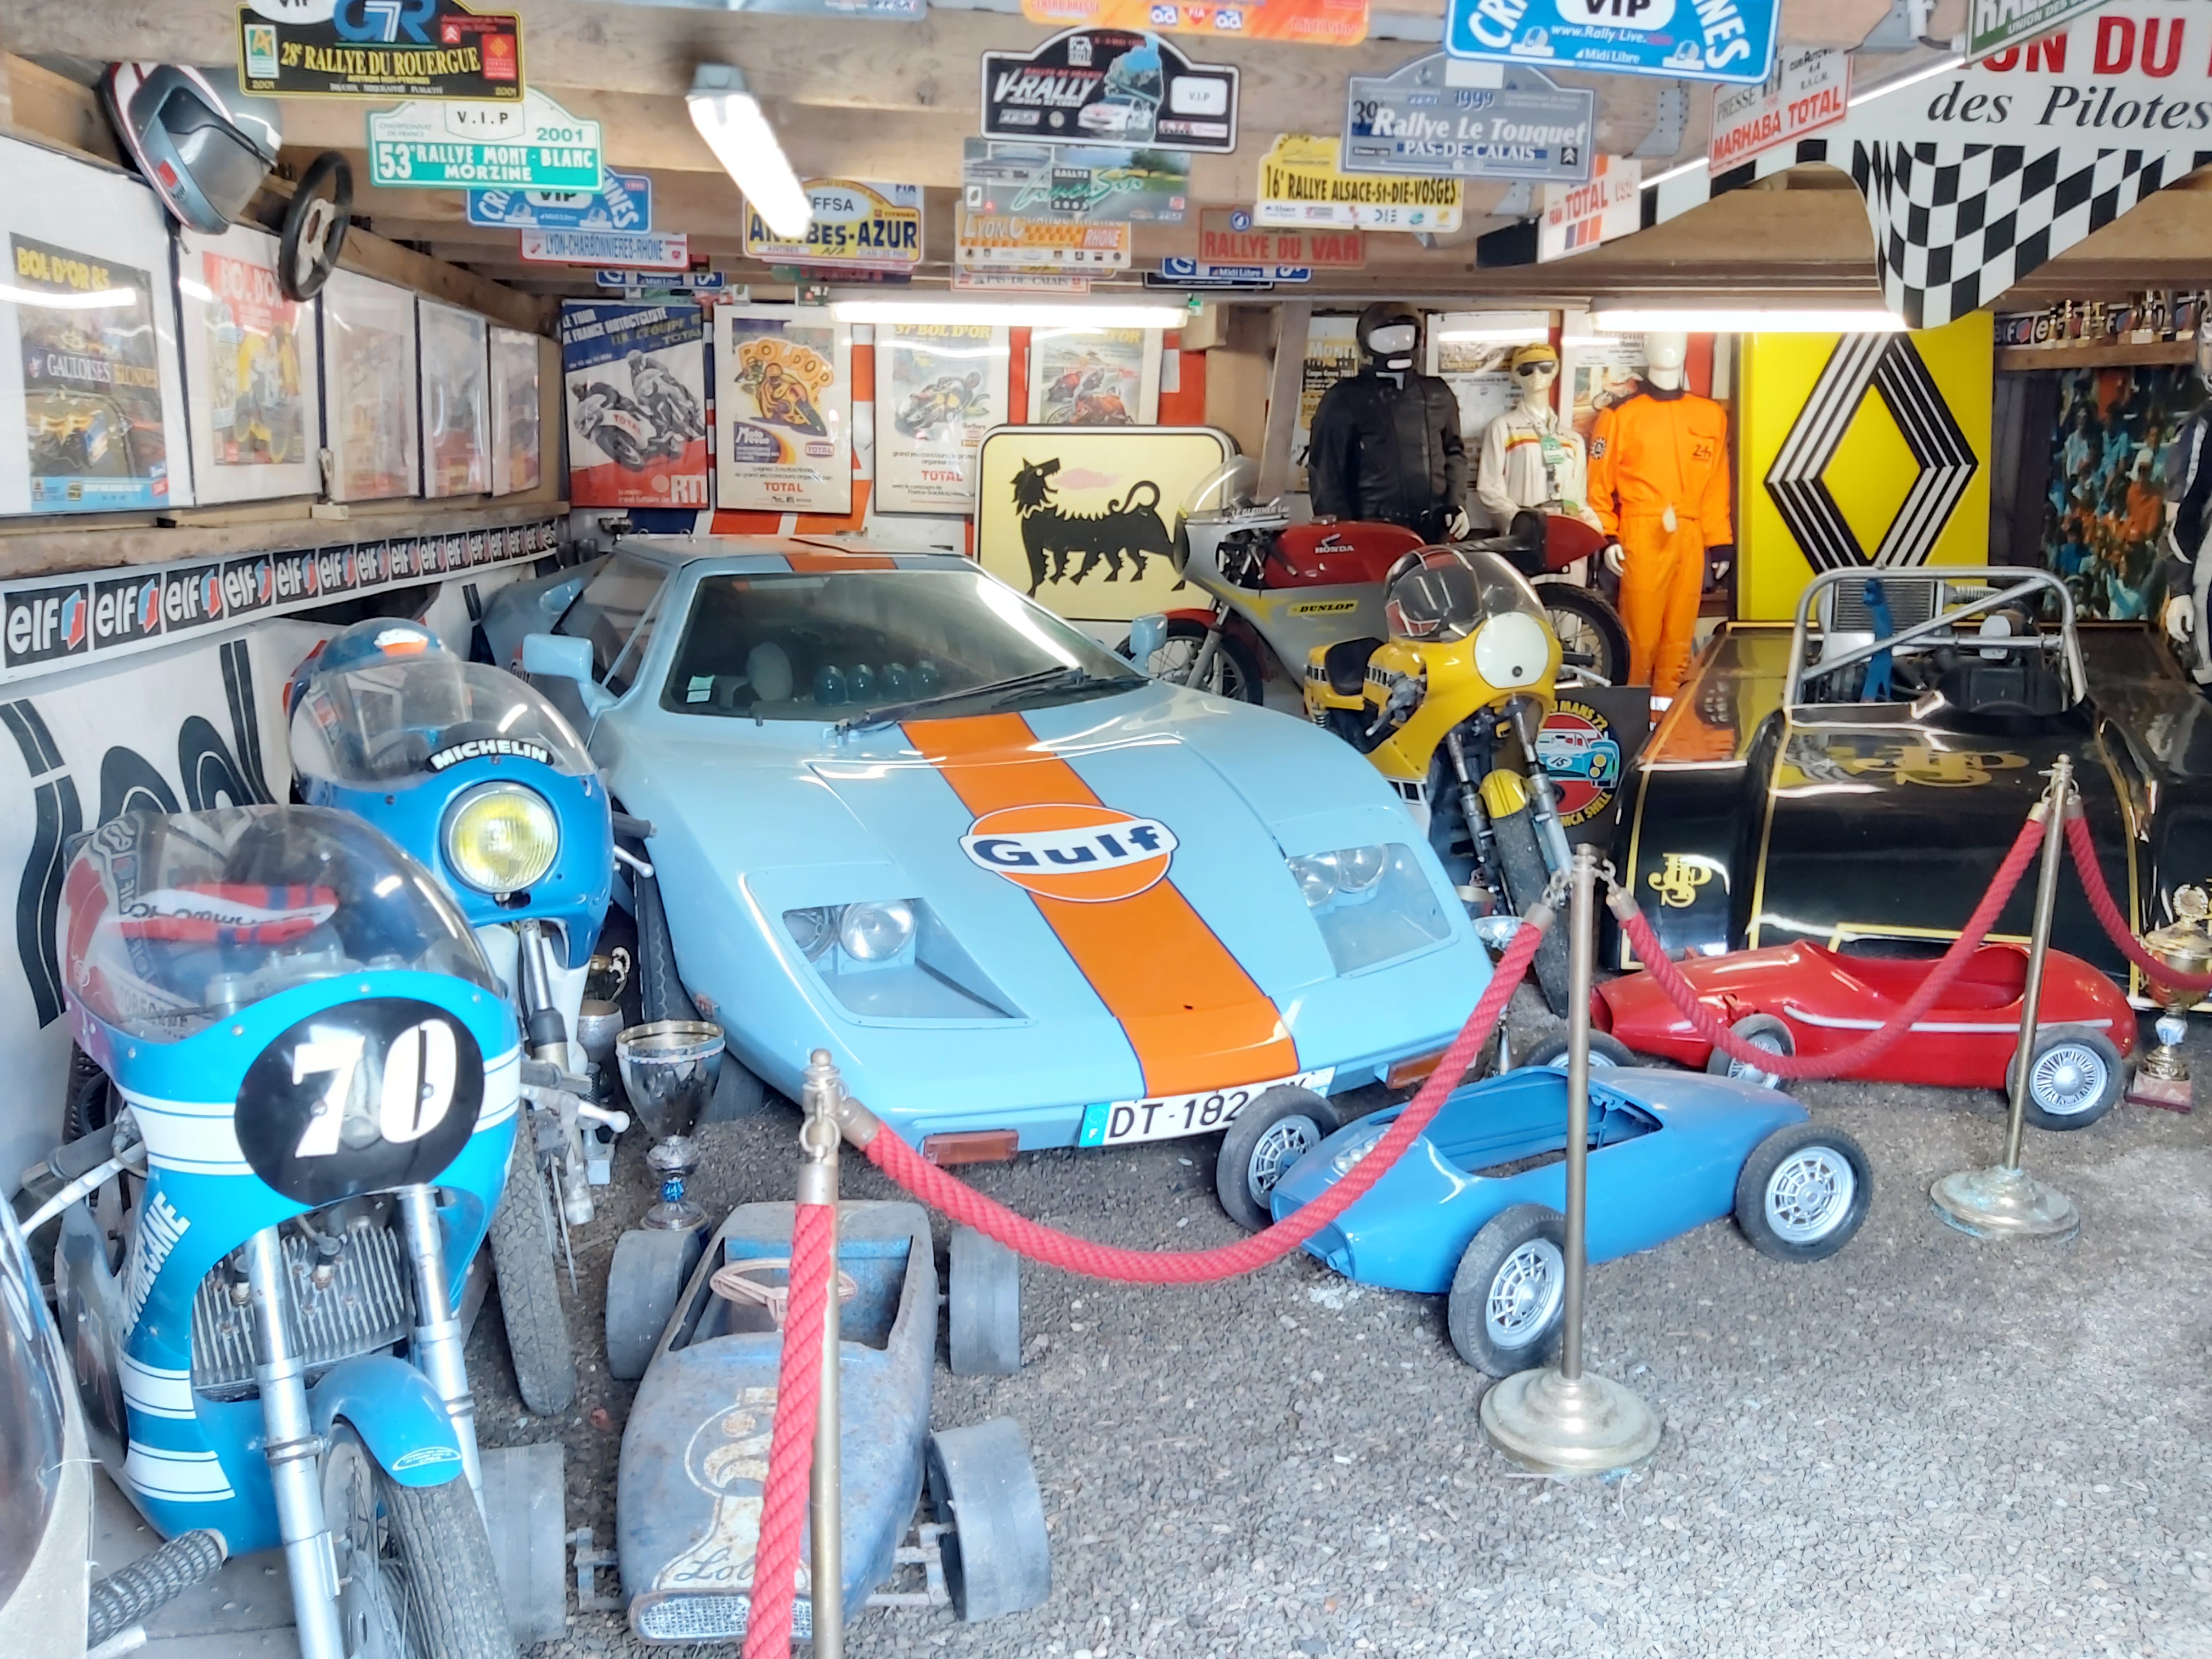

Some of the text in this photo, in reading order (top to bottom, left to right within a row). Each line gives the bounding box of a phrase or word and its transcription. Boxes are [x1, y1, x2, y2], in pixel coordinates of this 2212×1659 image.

[1189, 8, 1205, 17] FIA
[2007, 2, 2067, 34] UNION DES
[1585, 48, 1640, 64] Midi Libre
[2093, 16, 2186, 78] DU
[304, 46, 366, 74] RALLYE
[369, 51, 391, 75] DU
[393, 47, 481, 76] ROUERGUE
[993, 67, 1099, 105] V-RALLY
[1454, 89, 1494, 111] 1999
[1718, 86, 1756, 123] PRESSE
[1929, 81, 2212, 130] des Pilotes
[537, 127, 584, 142] 2001
[1371, 108, 1587, 148] Rallye Le Touquet
[1714, 86, 1842, 162] MARHABA TOTAL
[416, 145, 473, 164] RALLYE
[484, 147, 528, 166] MONT
[540, 149, 594, 168] BLANC
[1405, 140, 1536, 161] PAS-DE-CALAIS
[444, 165, 533, 183] MORZINE
[1288, 173, 1328, 201] RALLYE
[1565, 179, 1609, 219] TOTAL
[812, 197, 854, 212] FFSA
[1084, 228, 1120, 248] RHONE
[1205, 231, 1360, 261] RALLYE DU VAR
[16, 246, 110, 291] BOL D'OR 85
[572, 308, 597, 325] TOUR
[572, 322, 605, 342] FRANCE
[604, 307, 668, 334] MOTOCYCLISTE
[662, 329, 702, 345] TOTAL
[919, 324, 950, 338] BOL
[951, 326, 992, 341] D'OR
[46, 353, 110, 384] GAULOISES
[613, 414, 642, 436] TOTAL
[736, 426, 765, 444] Moto
[764, 482, 804, 493] TOTAL
[921, 470, 963, 482] TOTAL
[1314, 544, 1355, 554] HONDA
[7, 597, 60, 654] elf
[95, 585, 138, 637] elf
[165, 575, 201, 622] elf
[224, 564, 257, 608] elf
[276, 557, 302, 596] elf
[319, 552, 342, 588] elf
[358, 548, 378, 581] elf
[391, 543, 410, 574] elf
[420, 540, 438, 571] elf
[447, 537, 462, 566] elf
[470, 533, 484, 561] elf
[490, 532, 502, 557] elf
[1298, 601, 1355, 613] DUNLOP
[1559, 700, 1609, 732] MANS 72
[430, 739, 549, 770] MICHELIN
[1551, 757, 1568, 767] 15
[1583, 791, 1613, 819] SHELL
[973, 825, 1161, 867] Gulf
[292, 1019, 458, 1158] 70
[1088, 1128, 1098, 1139] F
